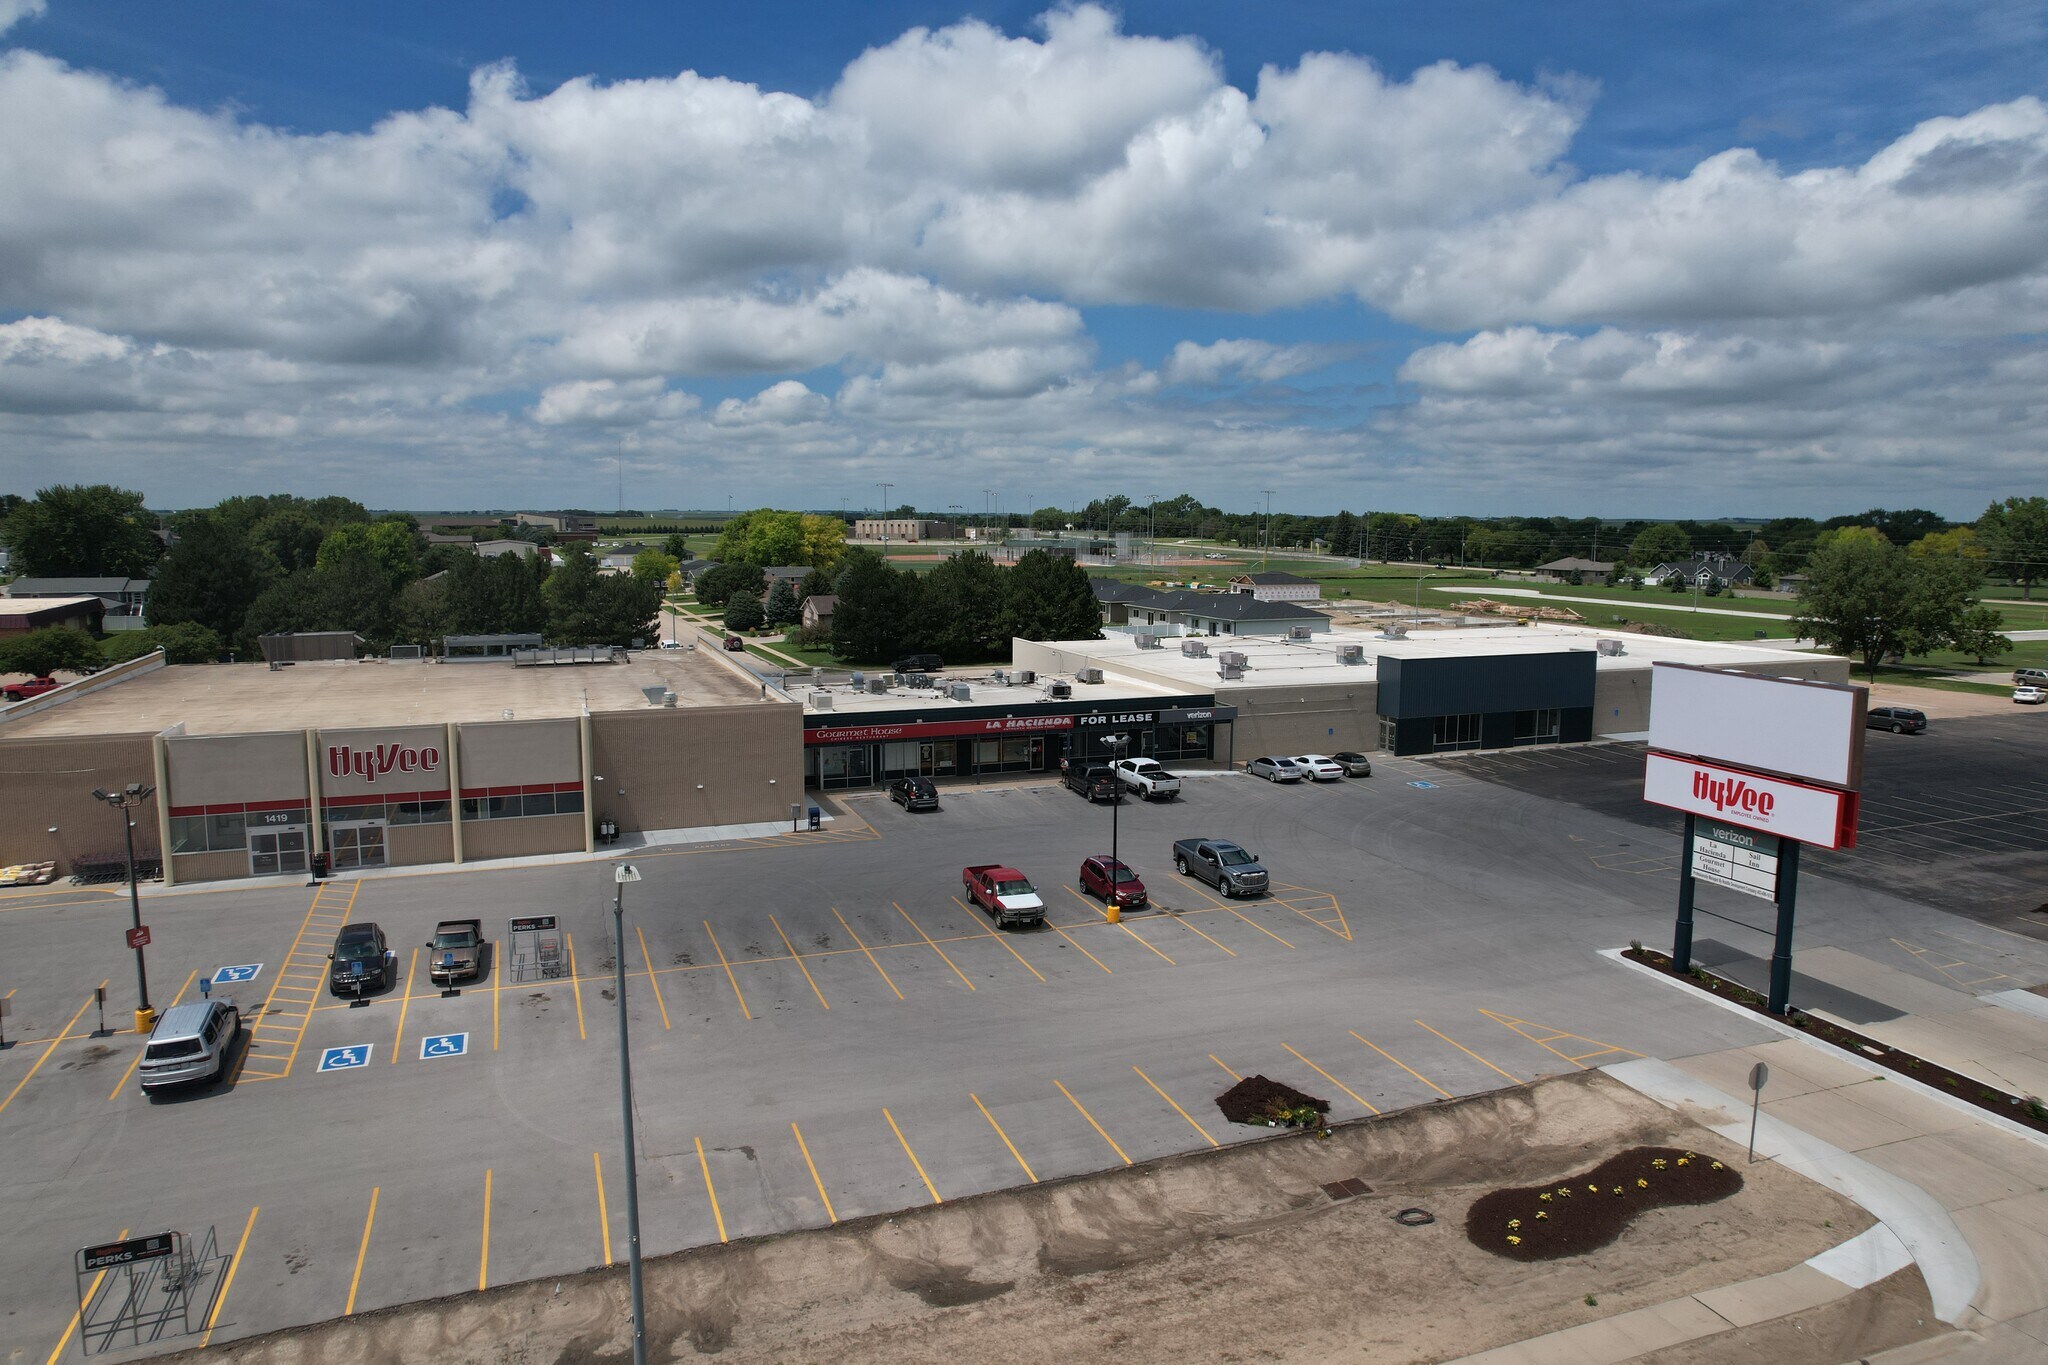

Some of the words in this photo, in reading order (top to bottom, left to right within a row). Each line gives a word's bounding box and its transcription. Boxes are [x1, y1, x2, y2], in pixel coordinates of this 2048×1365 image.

[1080, 716, 1106, 725] FOR
[1112, 714, 1152, 723] LEASE
[1187, 711, 1212, 719] verizon
[986, 721, 1002, 729] LA
[1006, 718, 1072, 728] HACIENDA
[264, 814, 288, 823] 1419
[1731, 810, 1752, 818] EMPLOYEE
[1712, 828, 1753, 846] verizon
[1700, 846, 1726, 858] Hacienda
[1700, 856, 1725, 868] Gourmet
[1703, 864, 1720, 874] House
[88, 1252, 133, 1267] PERKS
